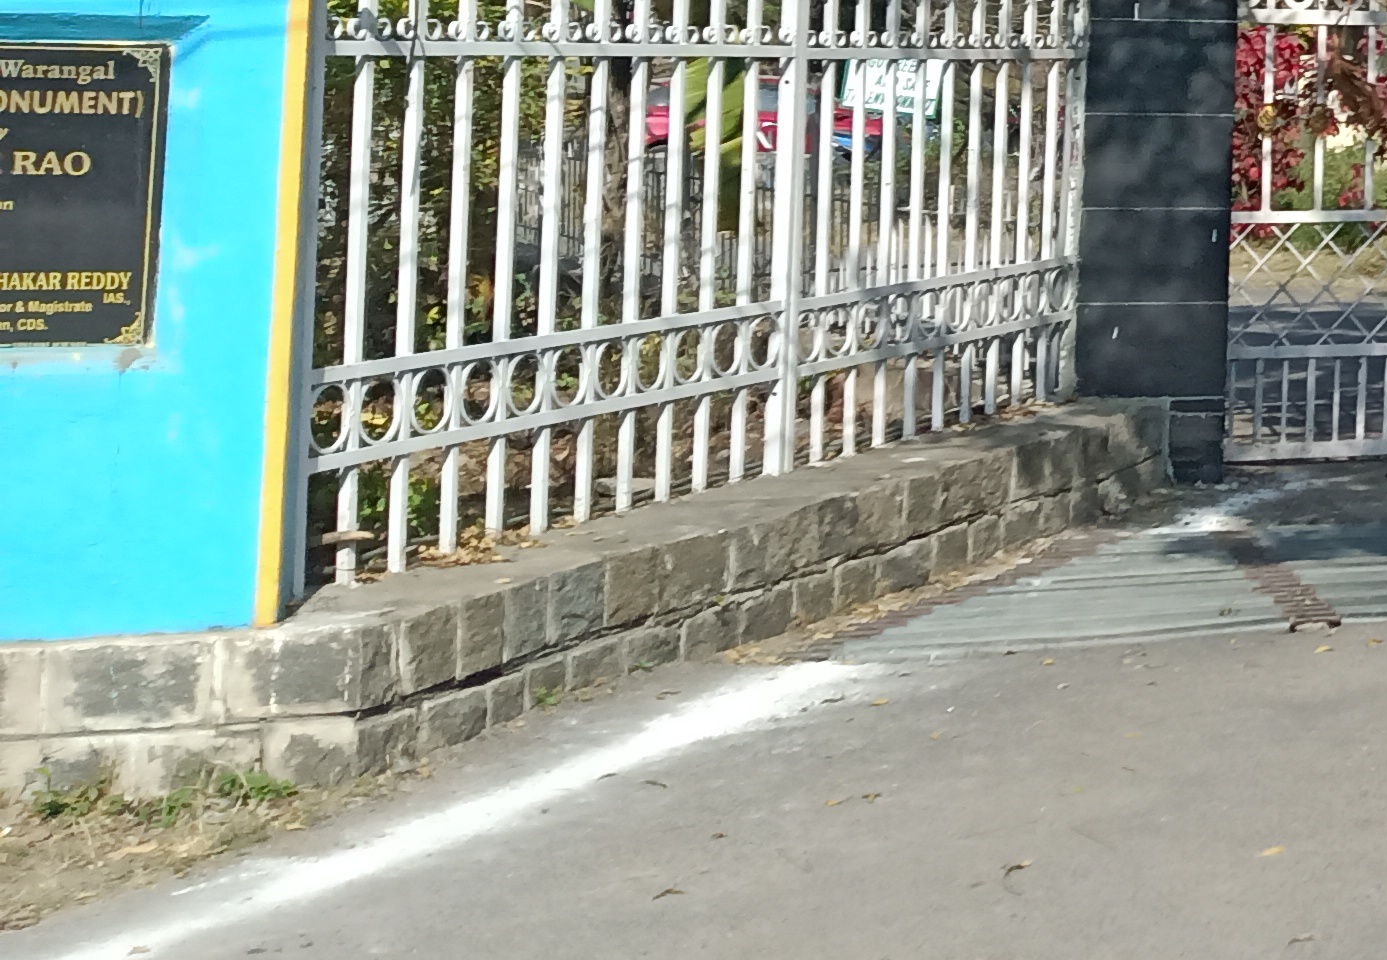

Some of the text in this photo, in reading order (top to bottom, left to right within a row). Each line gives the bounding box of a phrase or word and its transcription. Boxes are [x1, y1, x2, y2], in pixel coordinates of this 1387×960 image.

[0, 60, 115, 84] Warangal
[11, 150, 91, 175] RAO
[65, 271, 132, 290] REDDY
[15, 301, 25, 313] &
[28, 301, 93, 315] Magistrate
[17, 318, 48, 330] CDS.
